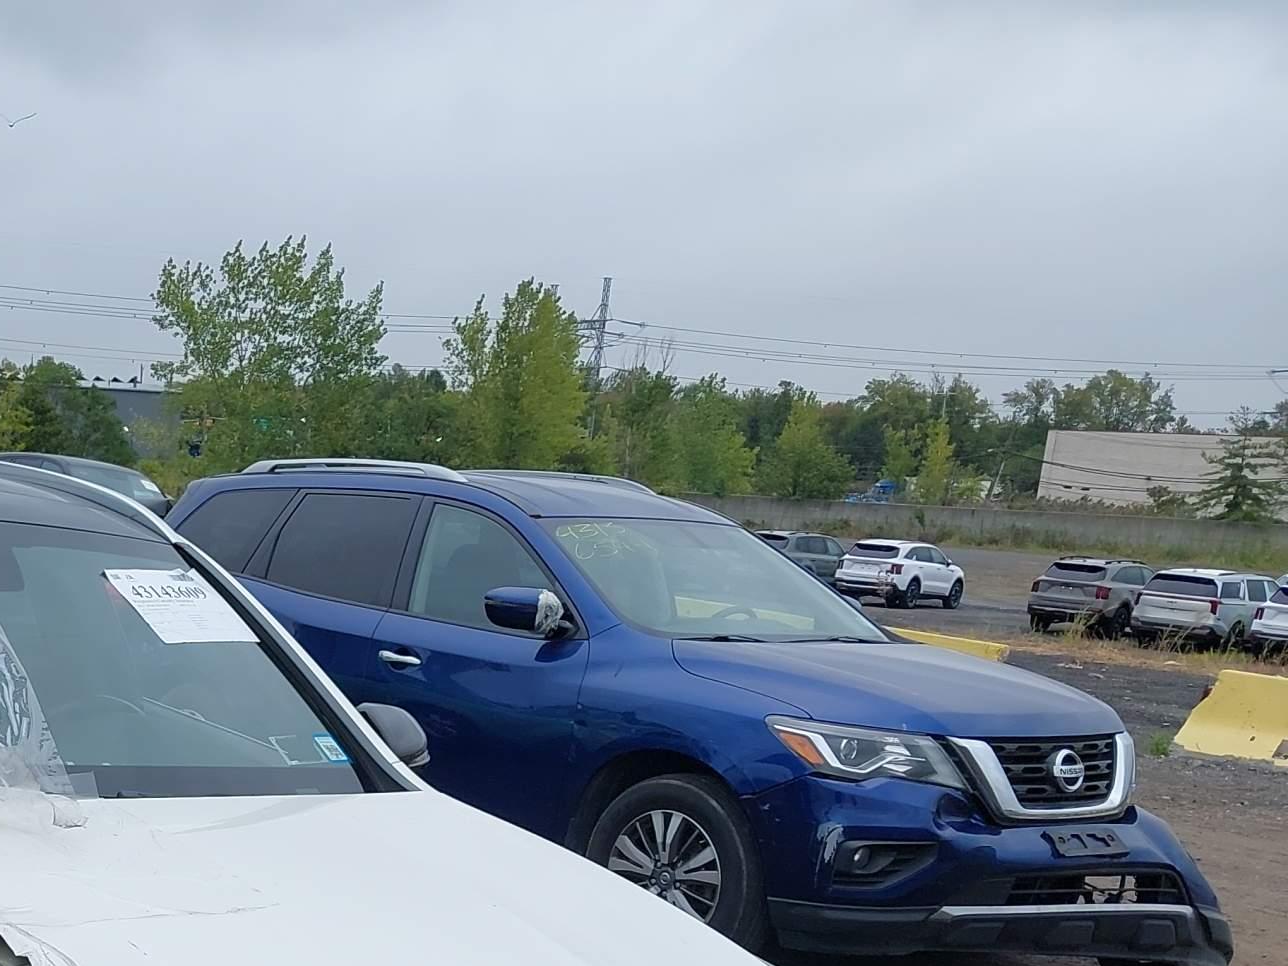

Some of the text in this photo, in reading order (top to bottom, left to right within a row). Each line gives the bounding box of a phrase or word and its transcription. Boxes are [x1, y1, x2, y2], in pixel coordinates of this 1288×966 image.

[575, 540, 656, 560] 65
[131, 585, 207, 600] 43143609
[1059, 767, 1082, 776] NISS
